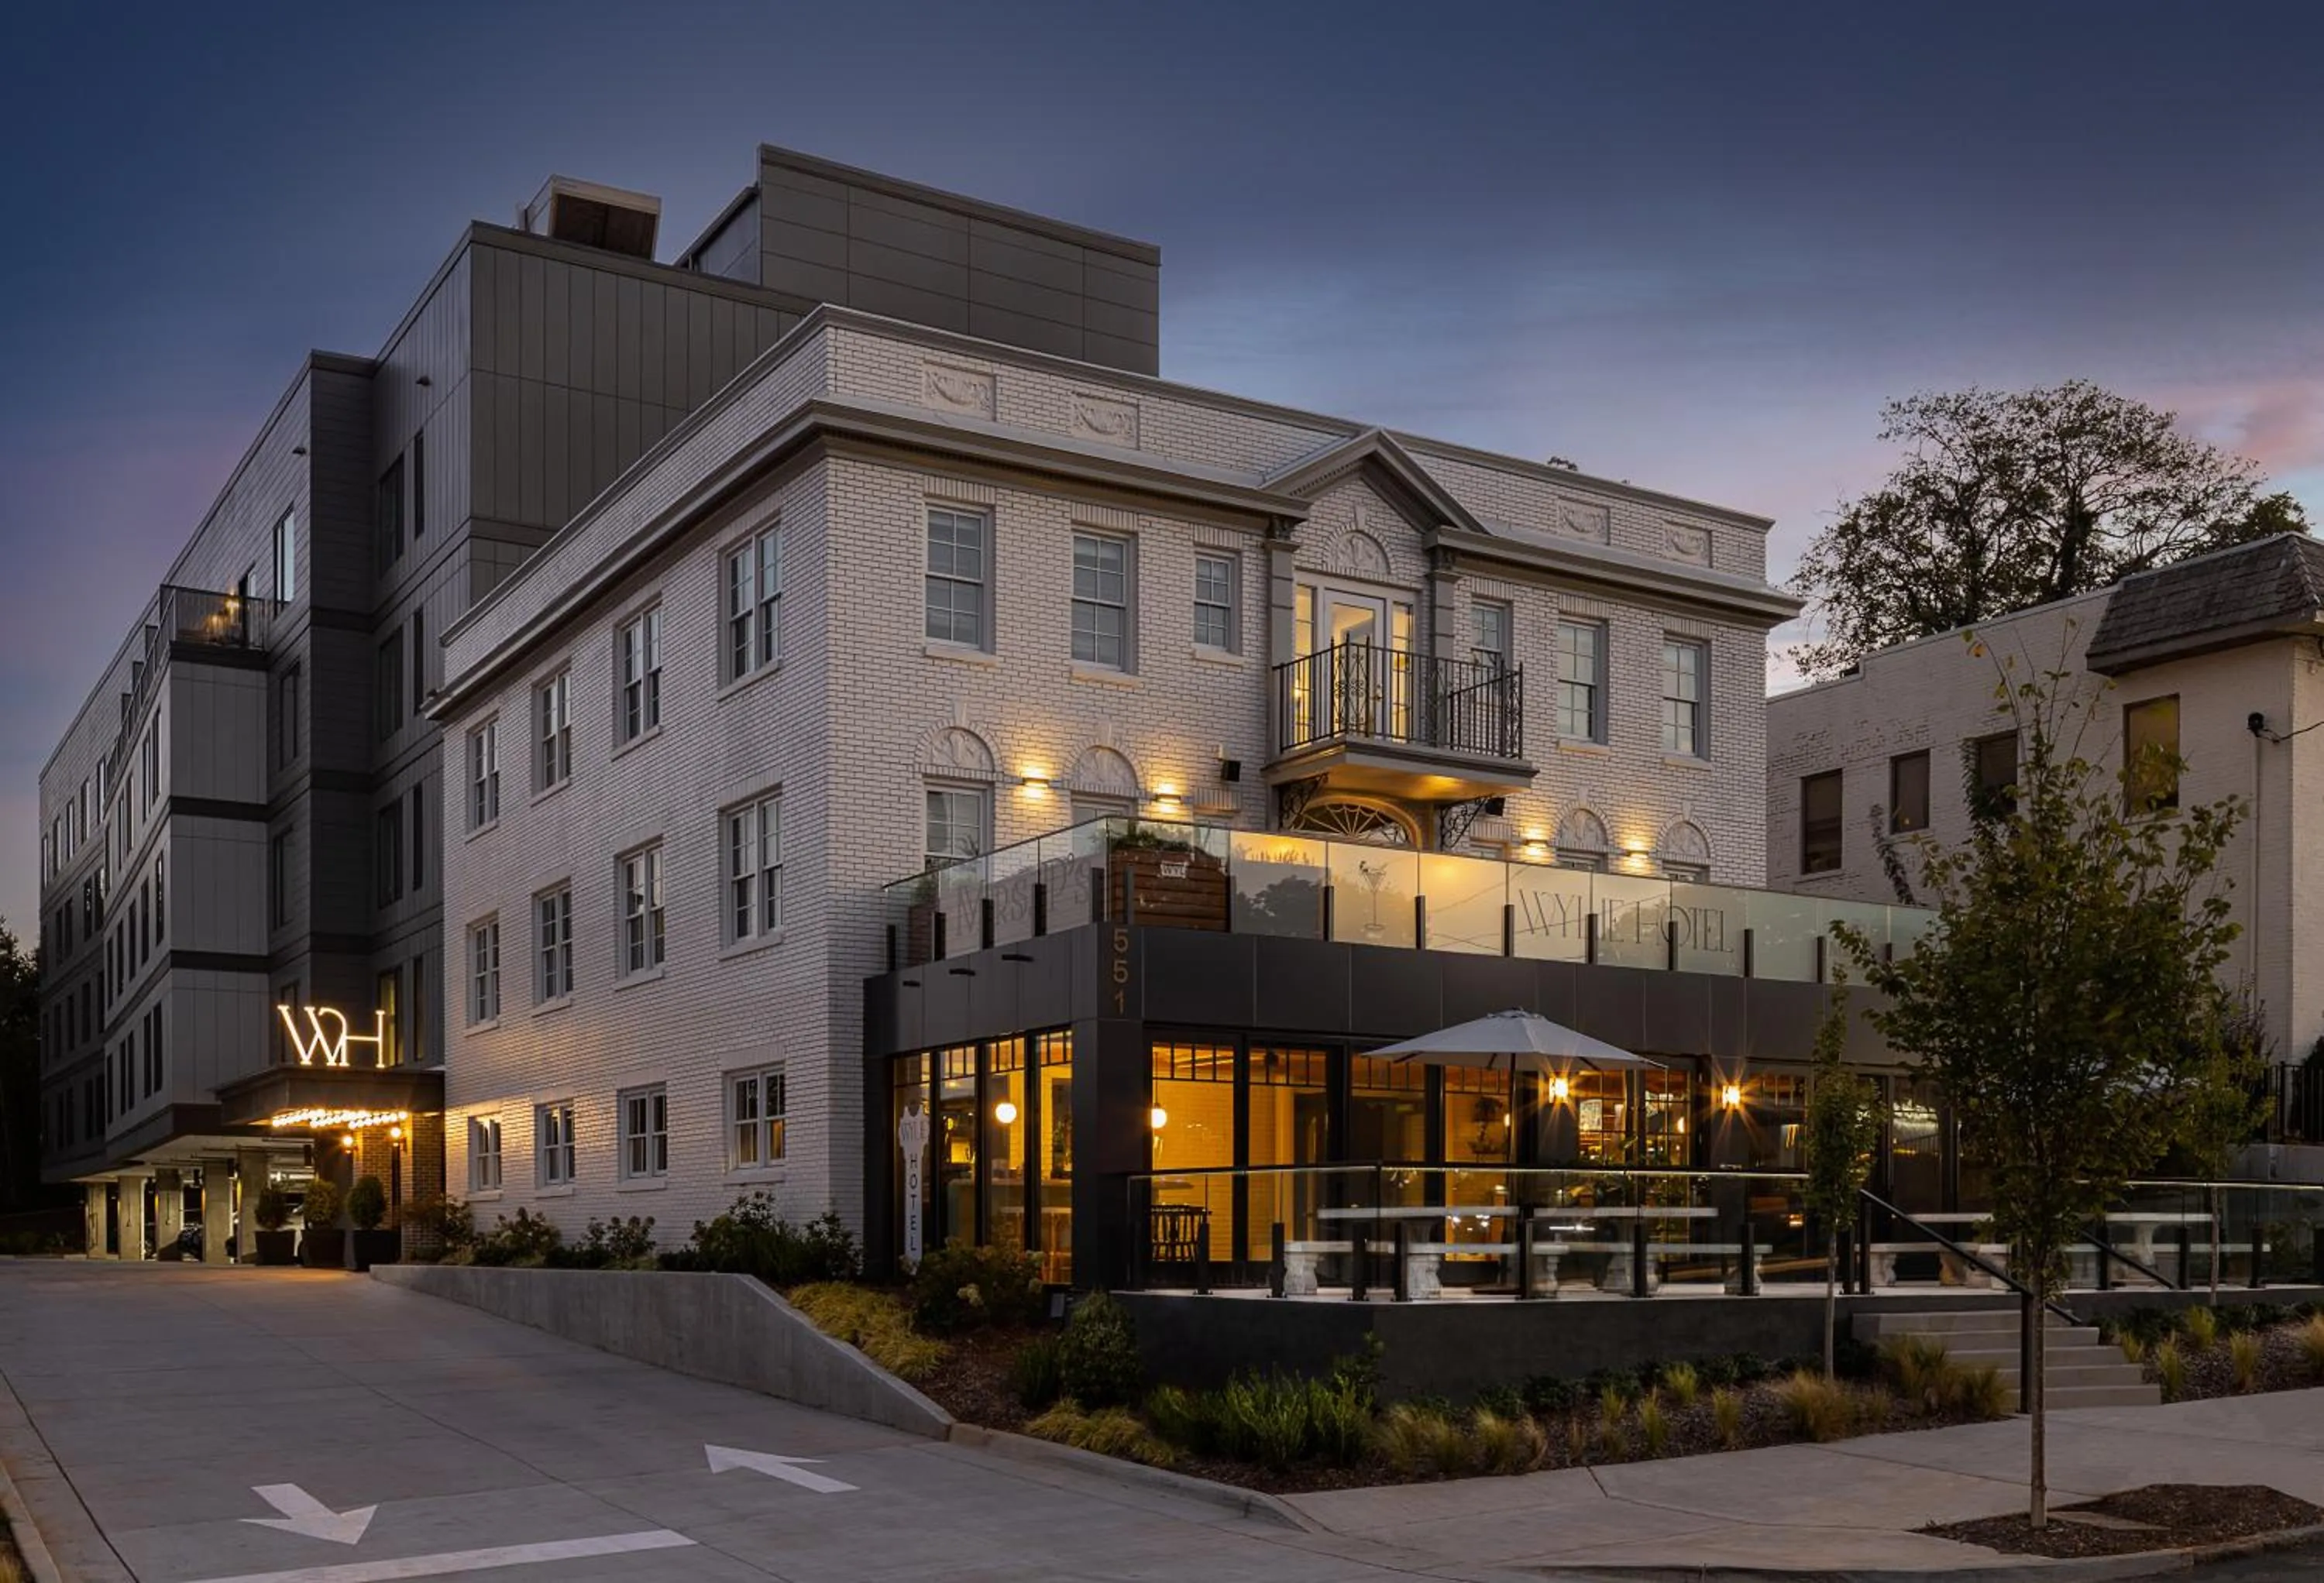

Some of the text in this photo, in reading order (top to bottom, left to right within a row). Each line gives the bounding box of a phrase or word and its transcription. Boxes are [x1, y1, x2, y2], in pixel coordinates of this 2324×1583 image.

[1635, 901, 1734, 953] HOTEL
[1112, 929, 1129, 1015] 551
[909, 1152, 918, 1252] HOTEL
